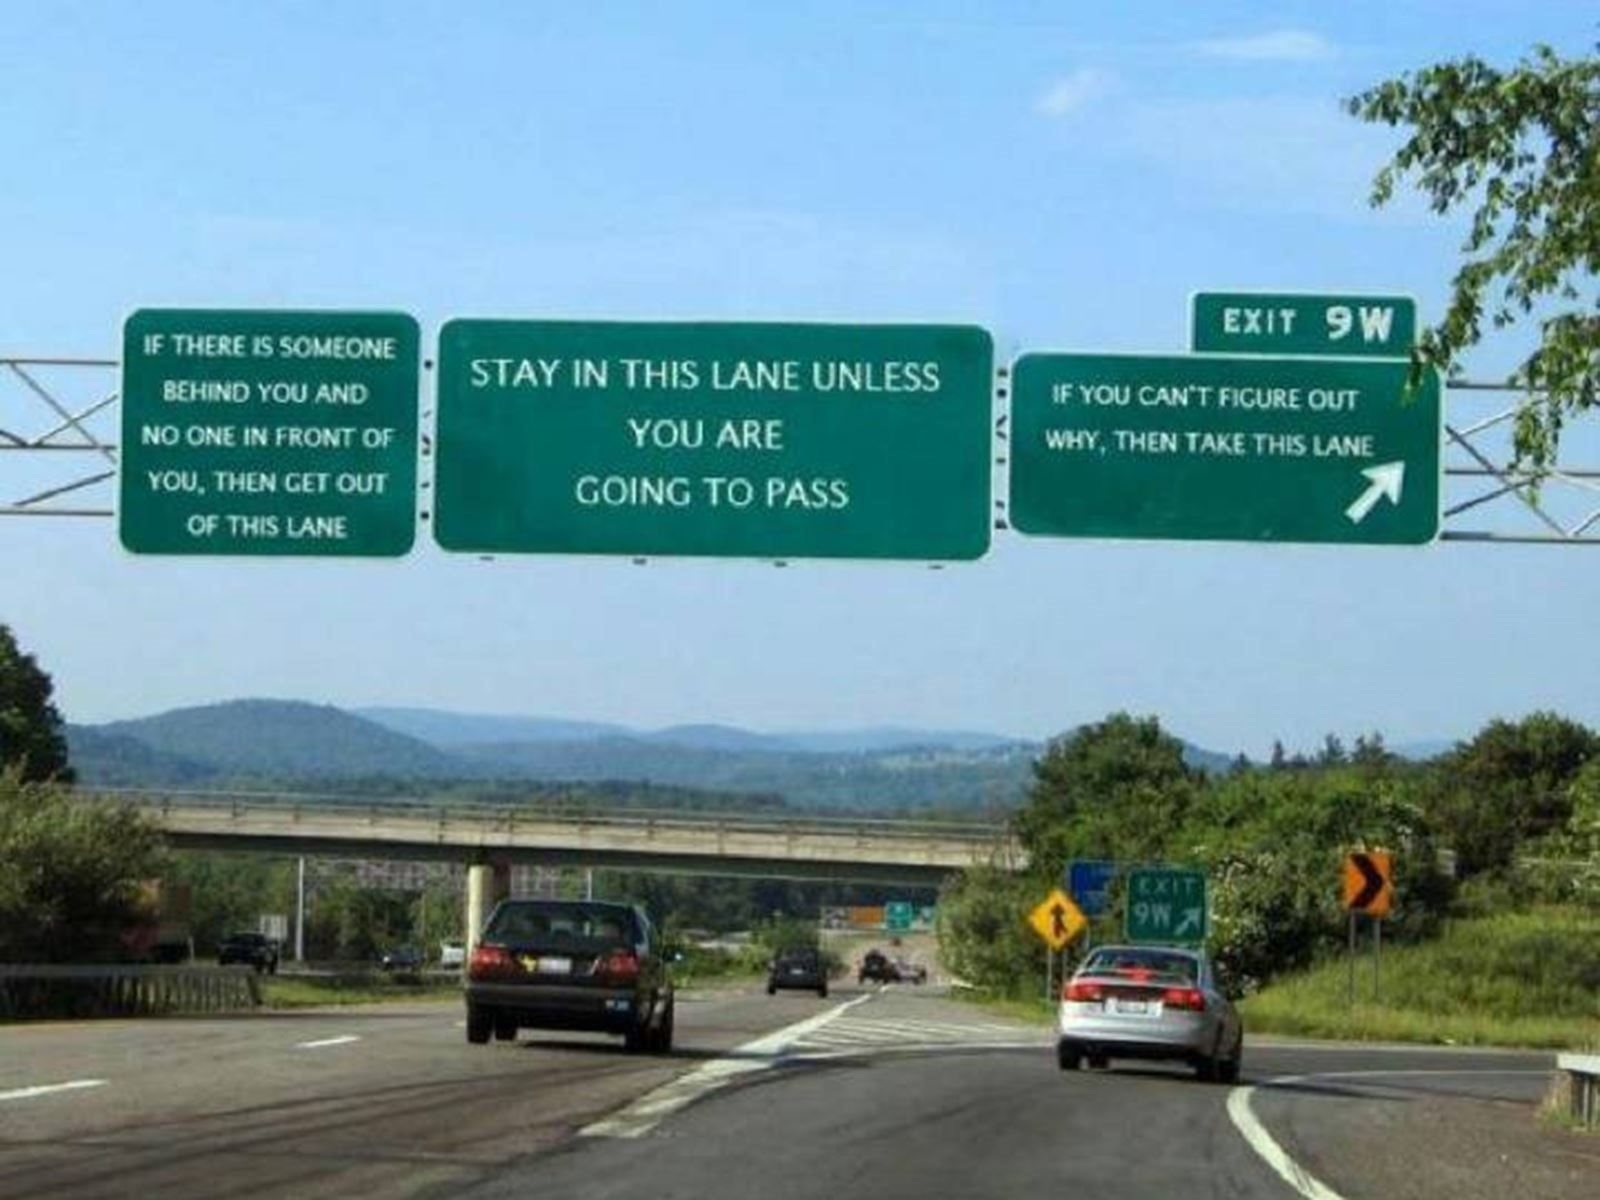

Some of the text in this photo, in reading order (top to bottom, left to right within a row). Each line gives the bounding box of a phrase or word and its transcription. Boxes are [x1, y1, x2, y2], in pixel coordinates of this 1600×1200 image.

[1223, 305, 1394, 342] EXIT 9W
[143, 333, 396, 360] IF THERE IS SOMEONE
[471, 358, 940, 393] STAY IN THIS LANE UNLESS
[163, 379, 368, 405] BEHIND YOU AND
[1052, 383, 1360, 411] IF YOU CAN'T FIGURE OUT
[141, 425, 394, 448] NO ONE IN FRONT OF
[627, 418, 783, 450] YOU ARE
[1045, 429, 1373, 457] WHY, THEN TAKE THIS LANE
[148, 470, 388, 495] YOU, THEN GET OUT
[575, 475, 849, 509] GOING TO PASS
[187, 514, 347, 539] OF THIS LANE
[1139, 876, 1198, 895] EXIT
[1134, 901, 1172, 928] 9W
